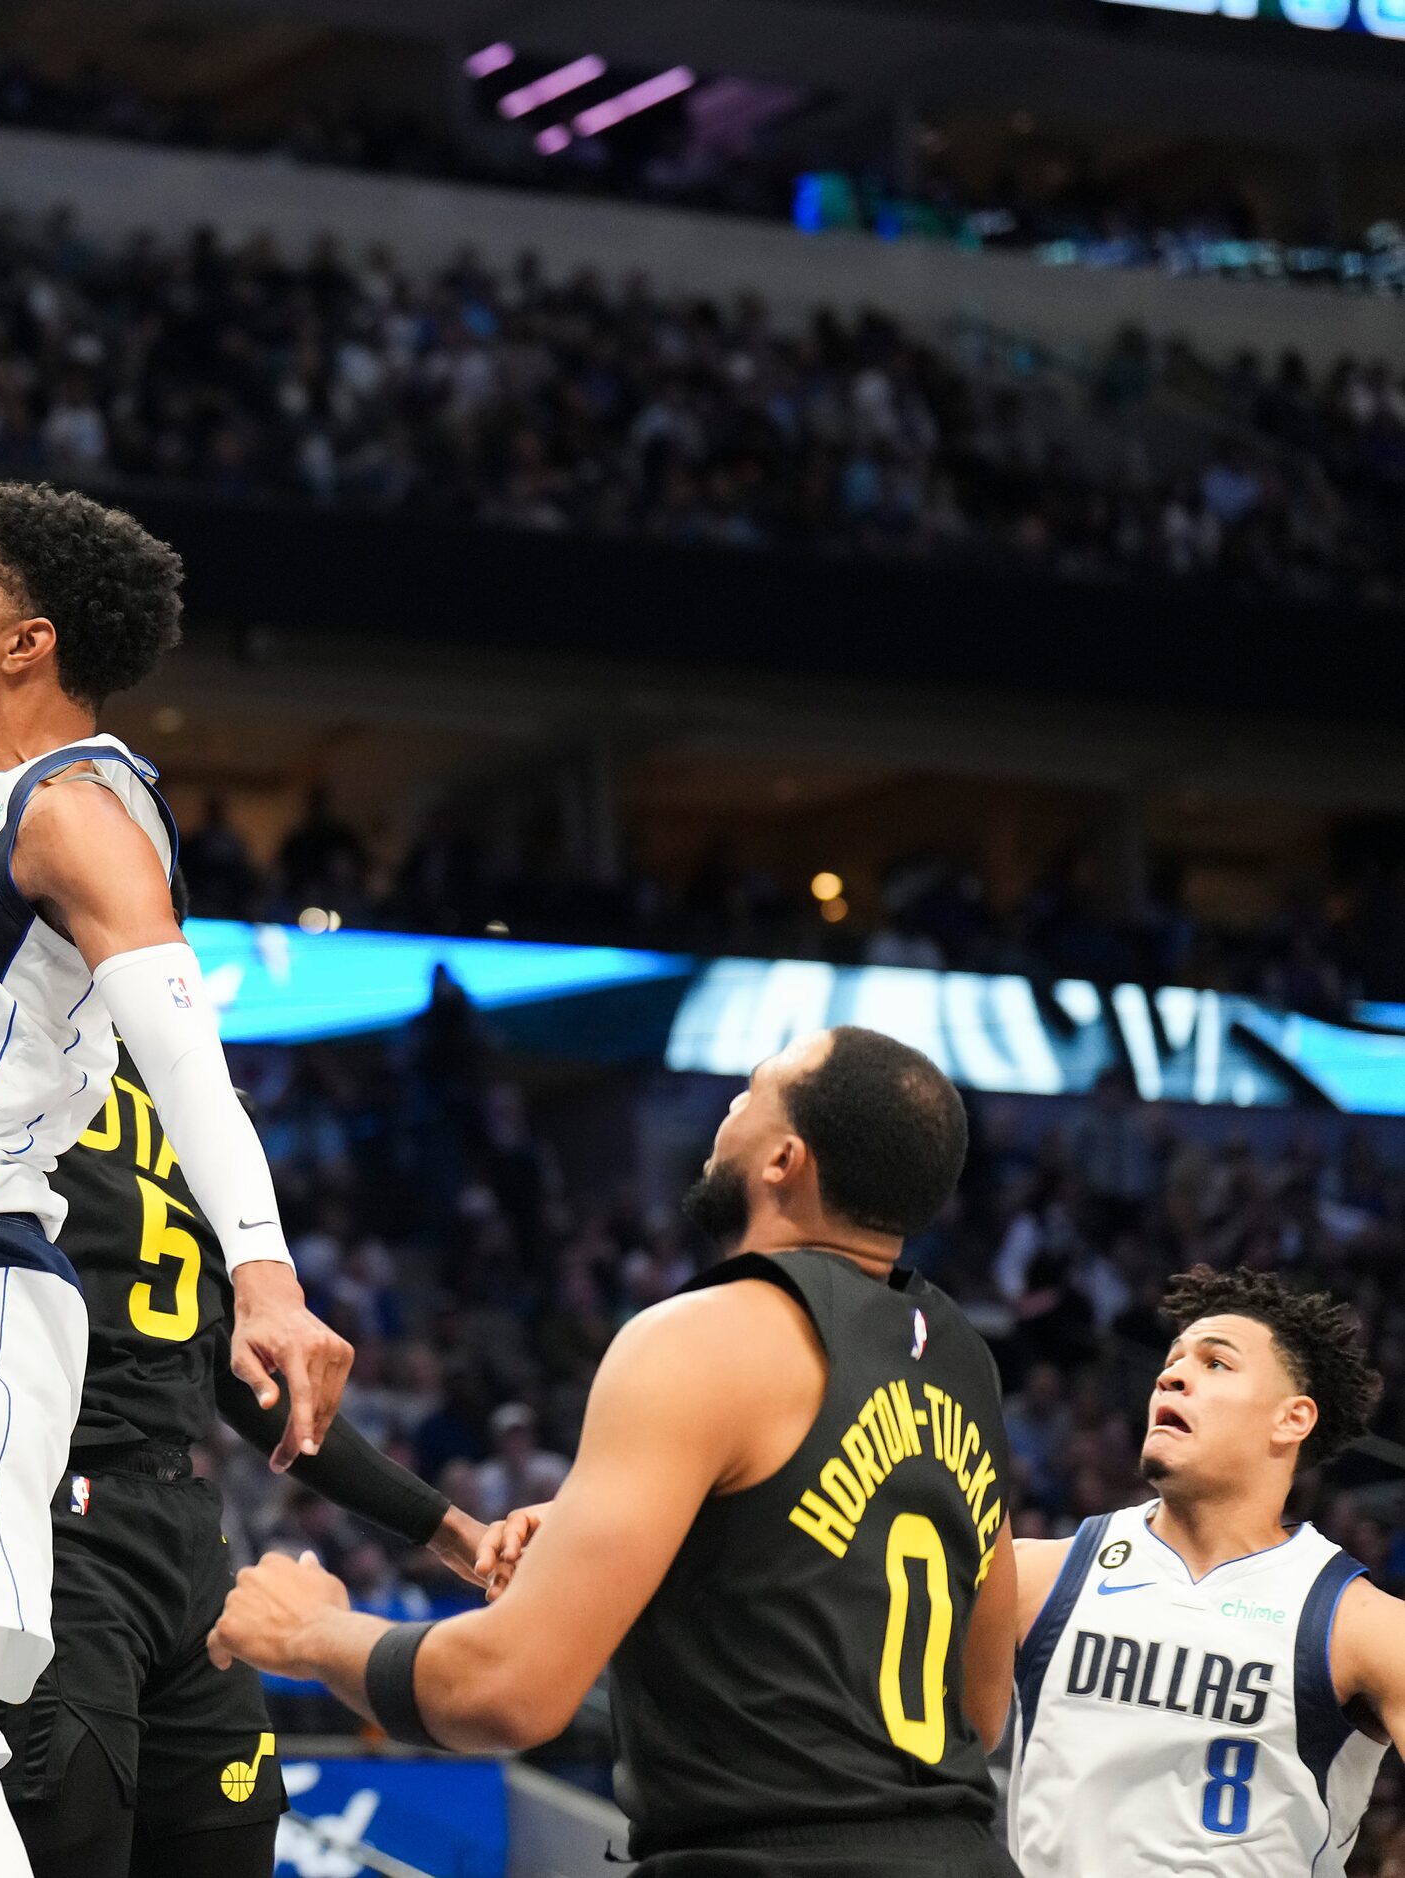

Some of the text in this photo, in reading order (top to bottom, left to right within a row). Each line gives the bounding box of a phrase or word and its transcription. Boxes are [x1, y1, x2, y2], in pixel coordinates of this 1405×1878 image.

[129, 1174, 201, 1343] 5
[1101, 1543, 1129, 1569] 6
[879, 1511, 953, 1765] 0
[1220, 1599, 1286, 1625] chime
[1064, 1629, 1275, 1729] DALLAS
[1200, 1735, 1261, 1836] 8
